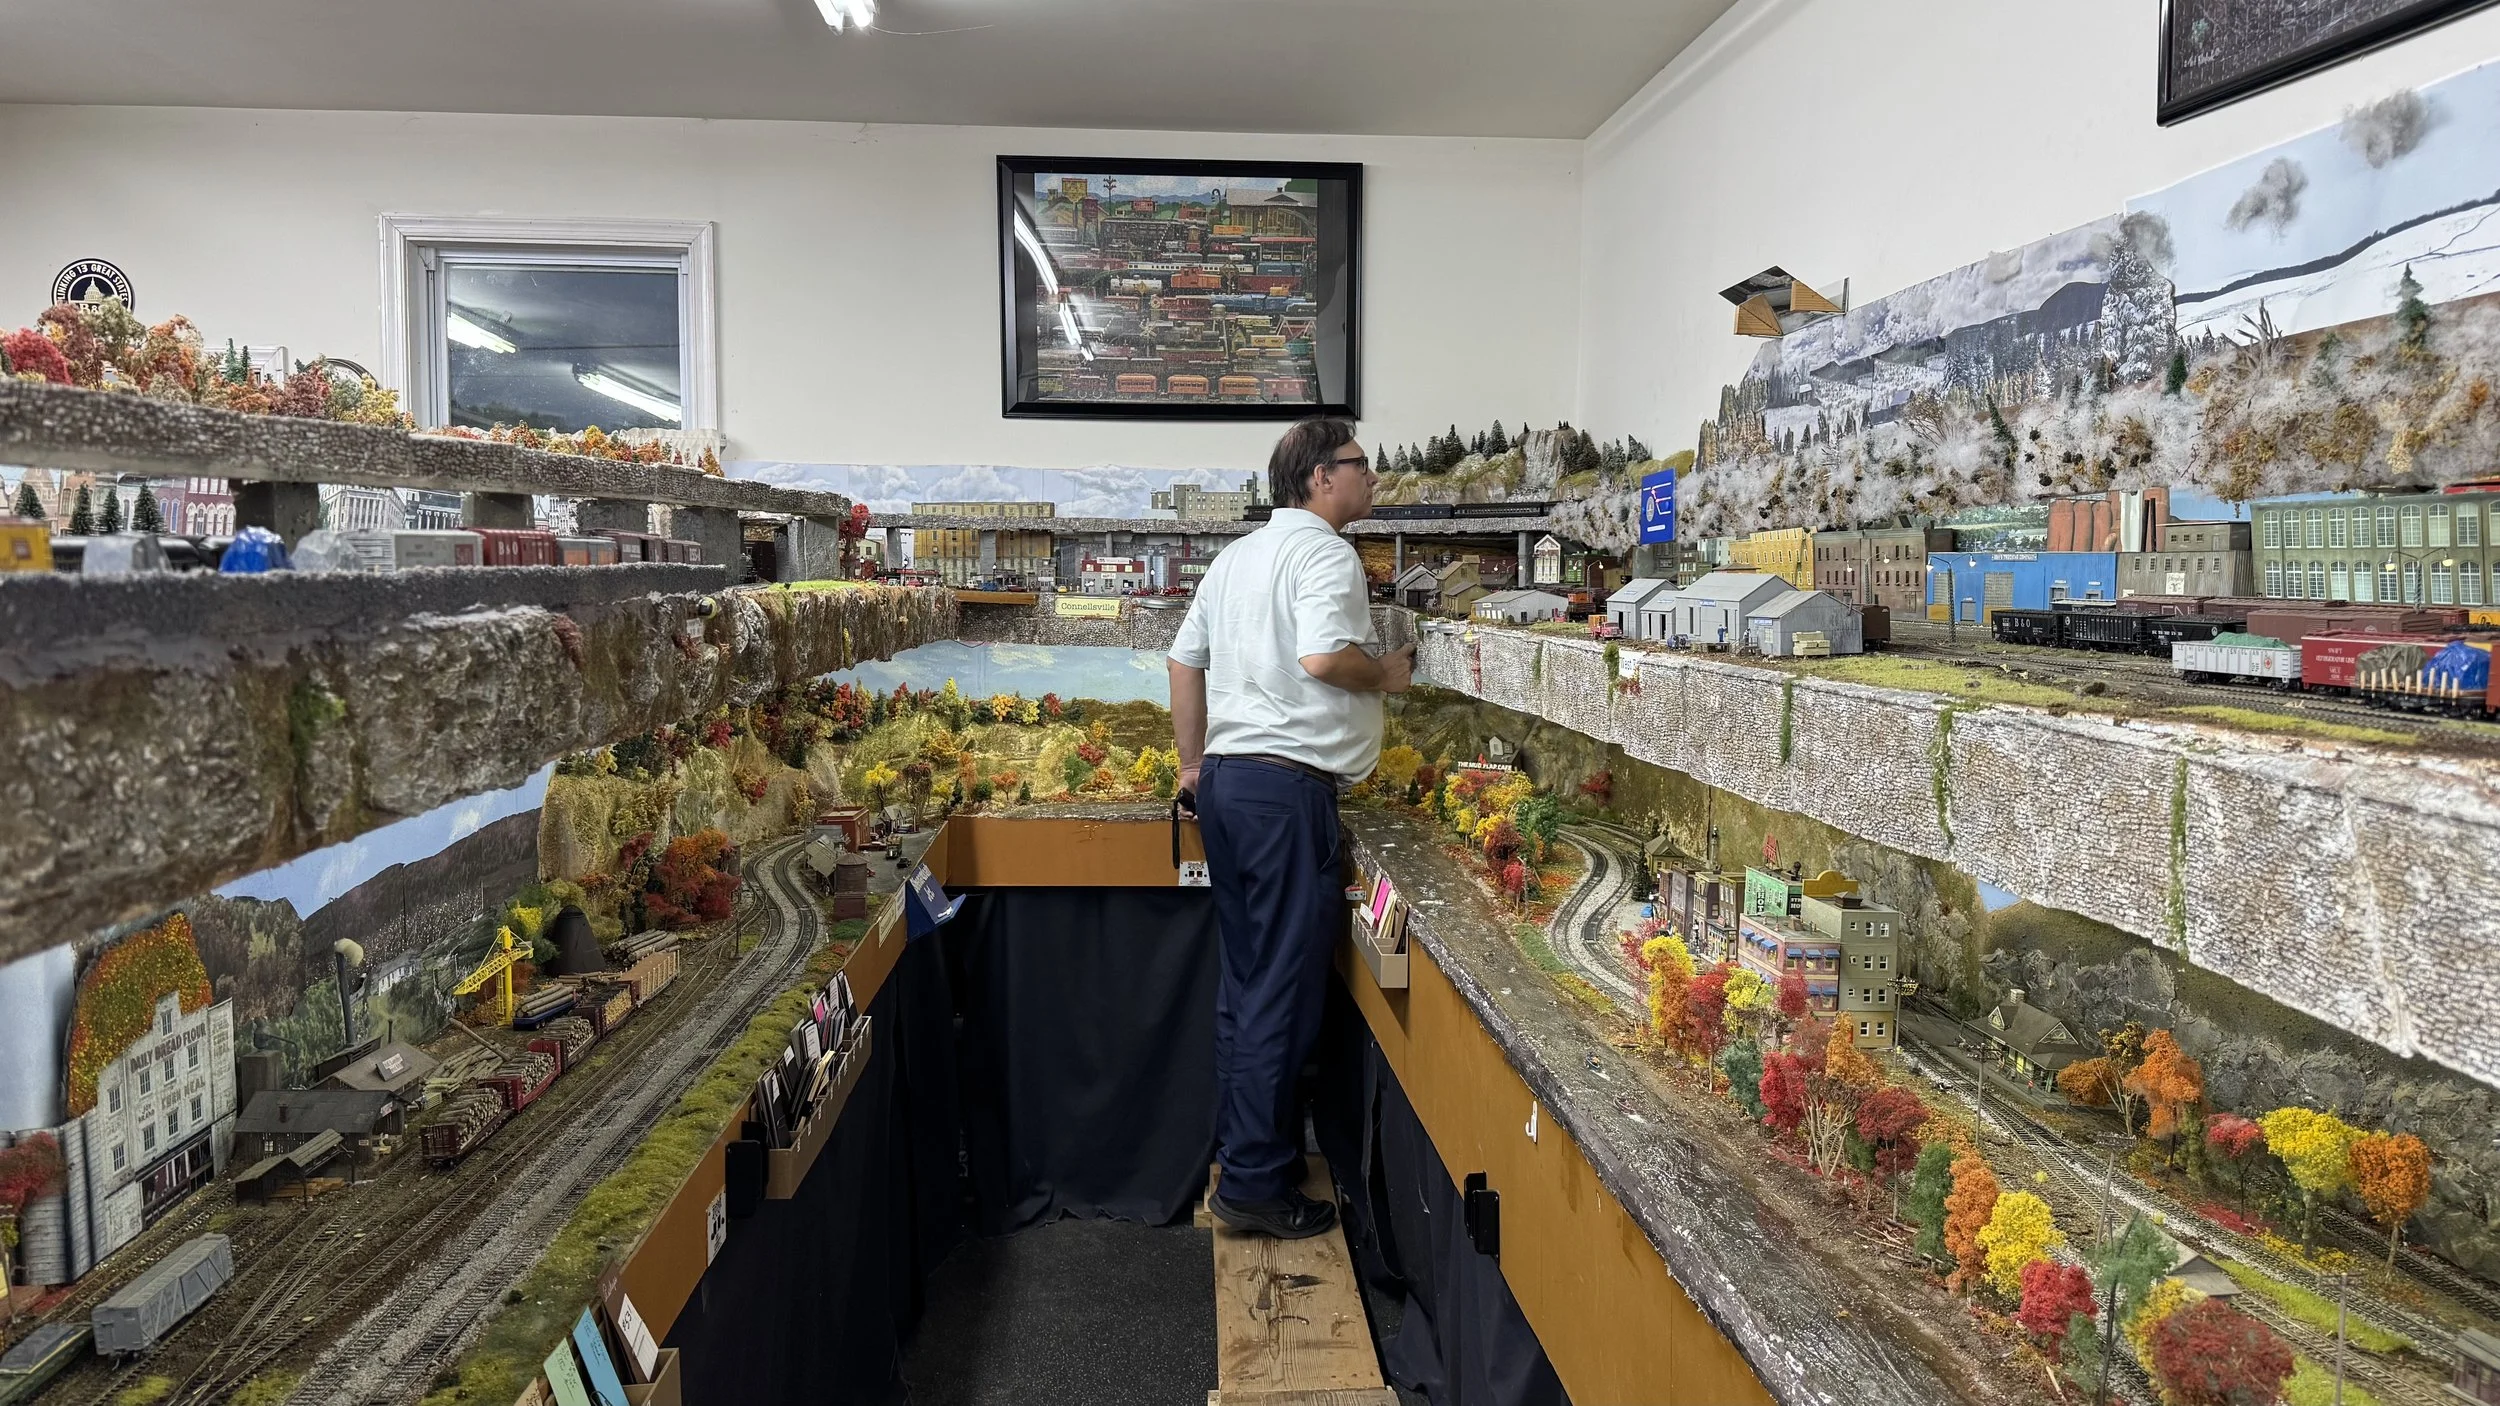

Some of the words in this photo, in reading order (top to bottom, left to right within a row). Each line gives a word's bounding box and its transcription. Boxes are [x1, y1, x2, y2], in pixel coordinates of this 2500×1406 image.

[57, 270, 77, 300] LINKING
[76, 264, 88, 274] 13
[91, 263, 116, 279] GREAT
[112, 276, 128, 302] STATES
[80, 303, 100, 314] B&
[1061, 602, 1115, 612] Connellsville
[131, 1049, 153, 1073] DAILY
[154, 1035, 182, 1060] BREAD
[182, 1023, 206, 1046] FLOUR
